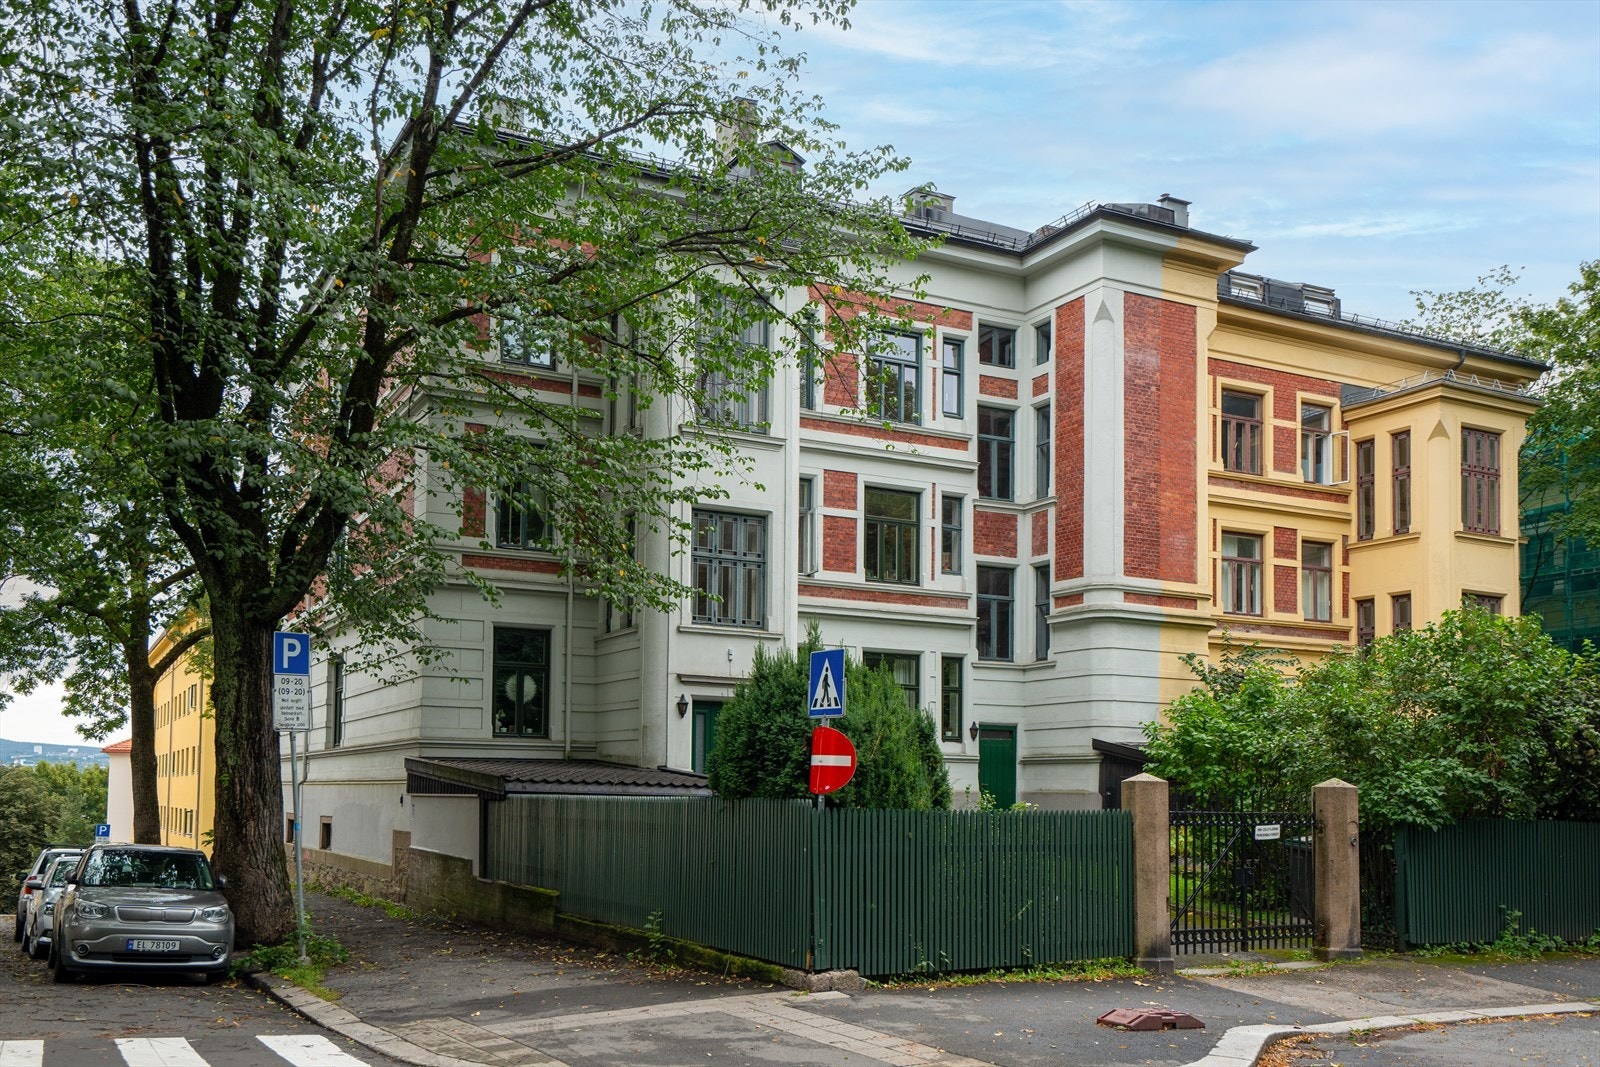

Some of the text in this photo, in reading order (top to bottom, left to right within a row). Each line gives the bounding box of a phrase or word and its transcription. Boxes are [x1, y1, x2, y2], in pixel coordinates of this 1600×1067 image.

[283, 638, 301, 669] P
[99, 825, 107, 835] P
[136, 941, 177, 950] EL 78109
